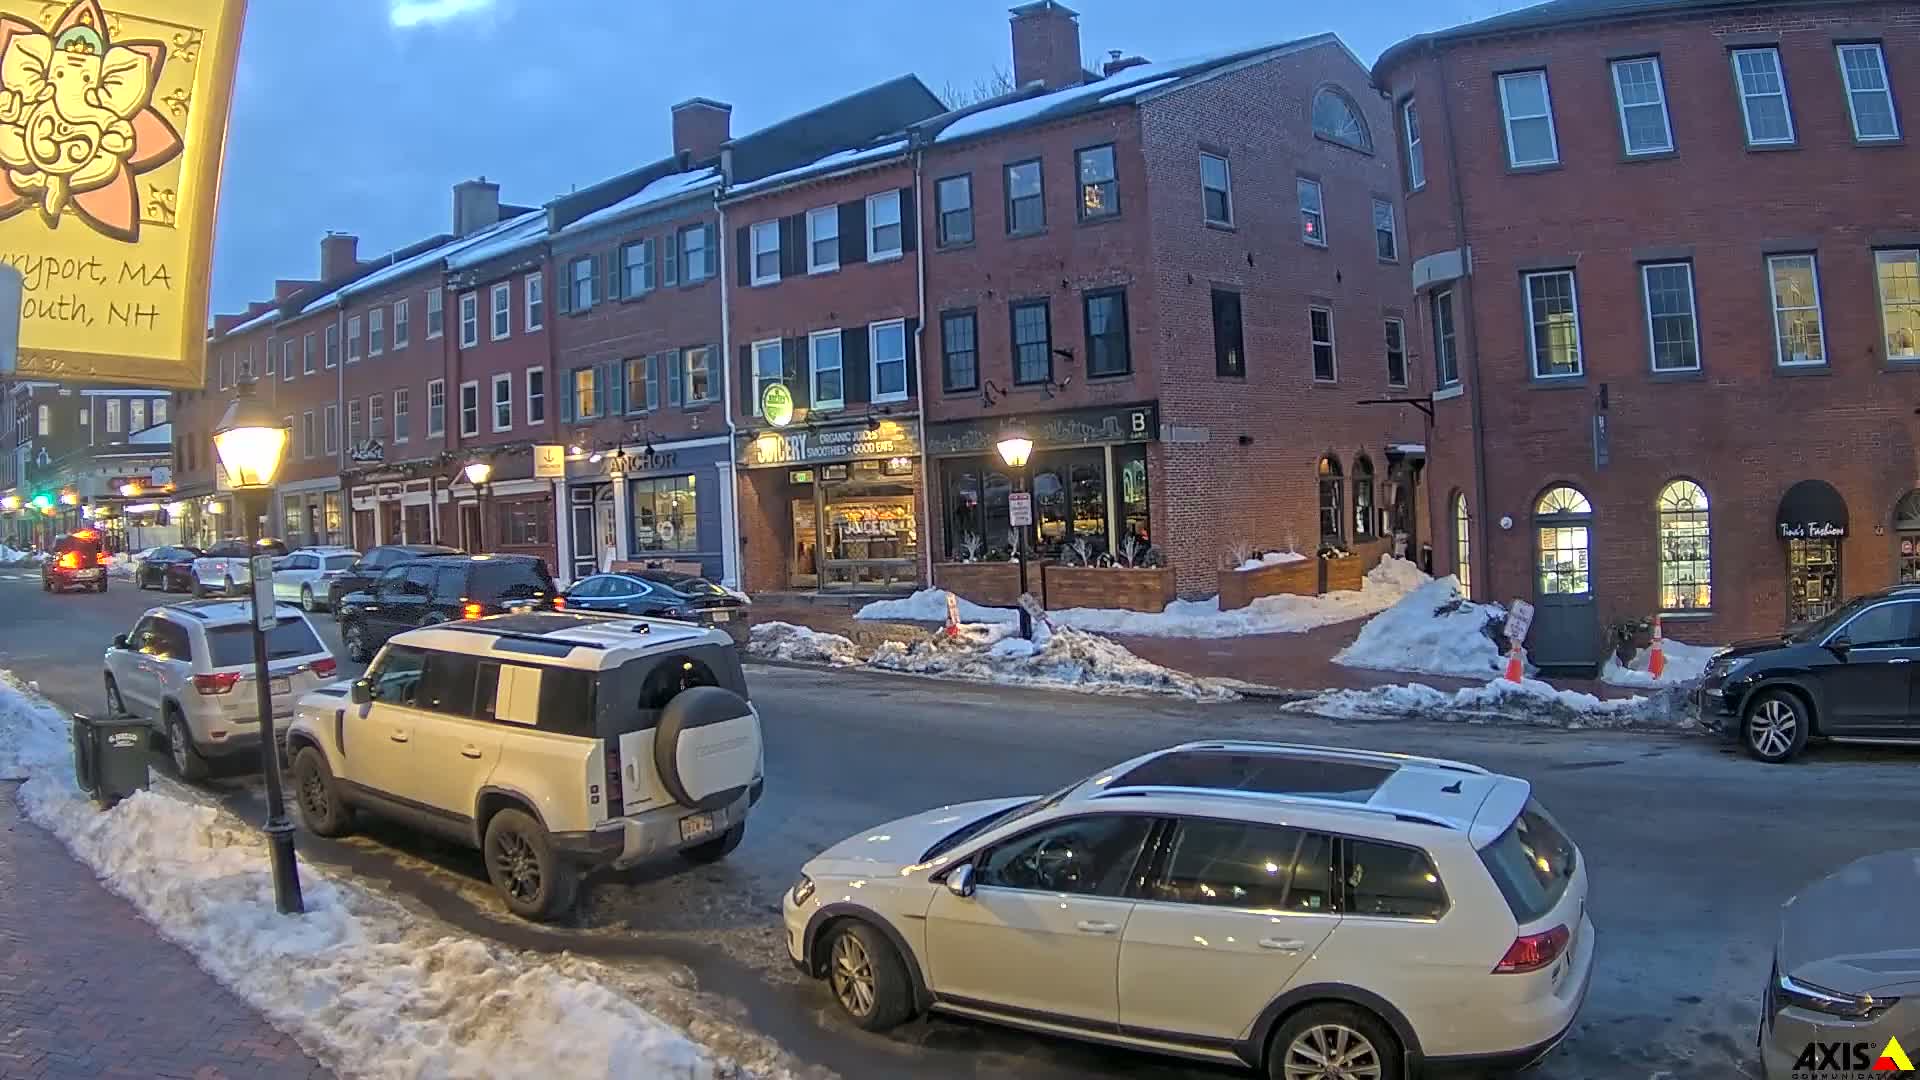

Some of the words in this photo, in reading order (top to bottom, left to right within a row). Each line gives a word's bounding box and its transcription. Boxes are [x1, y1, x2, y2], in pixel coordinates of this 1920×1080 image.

[0, 253, 107, 291] ryport,
[118, 261, 172, 290] MA
[22, 294, 95, 325] outh,
[107, 302, 160, 330] NH
[1131, 412, 1146, 432] B
[819, 432, 850, 445] ORGANIC
[852, 429, 879, 442] JUICES
[757, 434, 807, 464] JUICERY
[807, 444, 847, 458] SMOOTHIES
[852, 441, 875, 454] GOOD
[875, 440, 894, 453] EATS
[610, 452, 679, 473] ANCHOR
[1780, 522, 1805, 537] Tina's
[1807, 521, 1844, 537] Fashions
